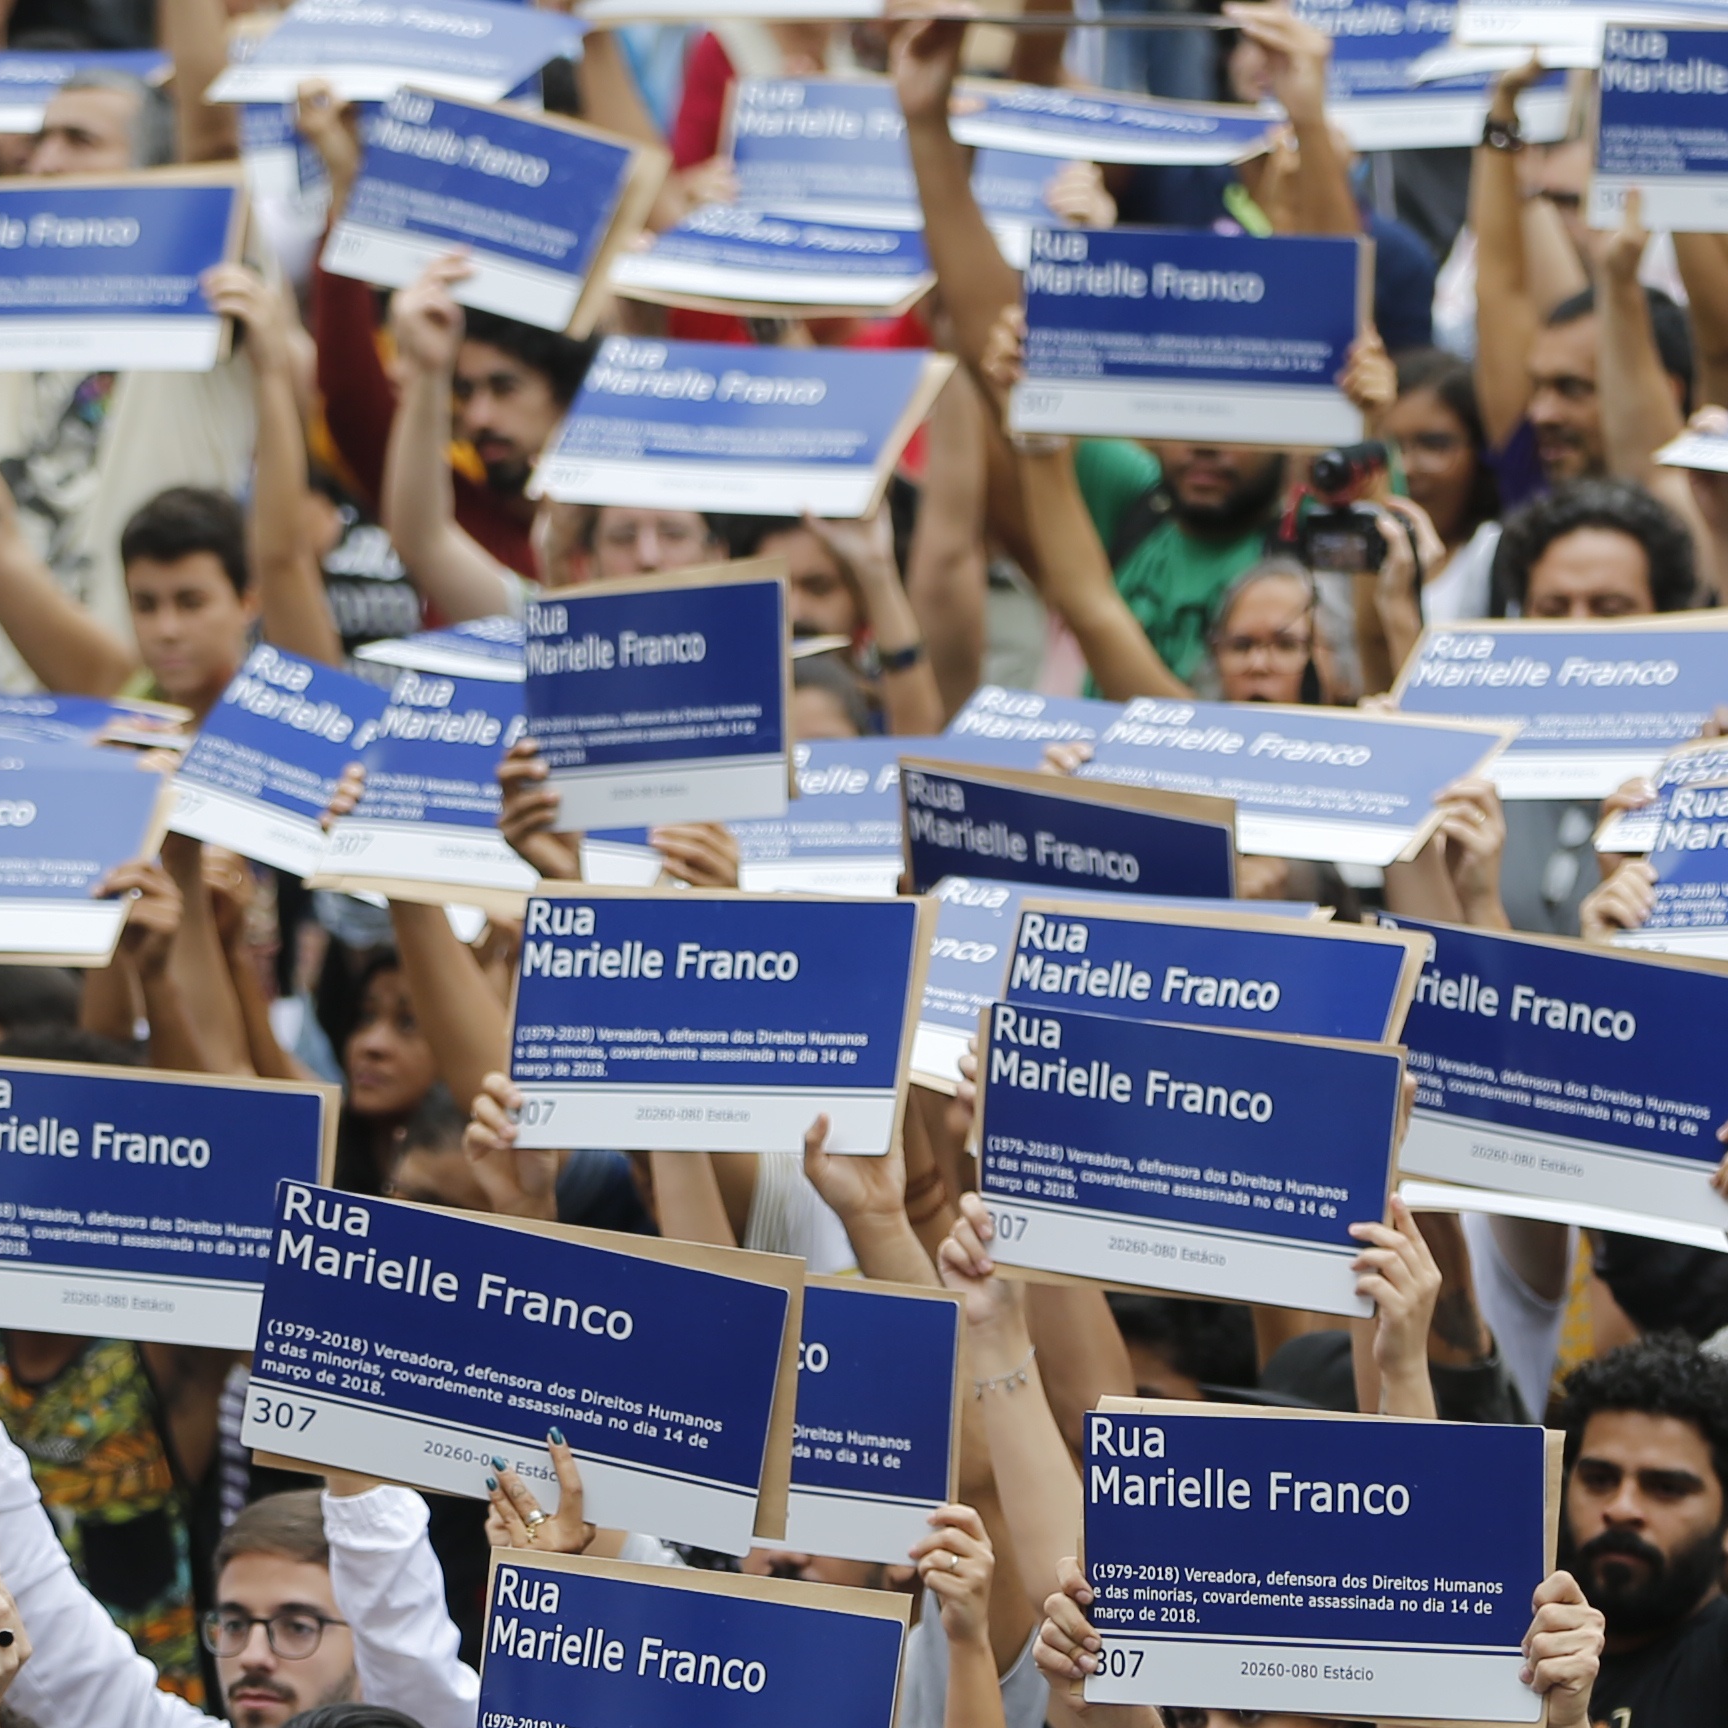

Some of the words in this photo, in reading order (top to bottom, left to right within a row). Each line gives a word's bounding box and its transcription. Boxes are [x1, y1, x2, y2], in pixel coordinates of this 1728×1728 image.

[908, 773, 965, 813] Rua
[909, 808, 1028, 863] Marielle
[1034, 830, 1140, 884] Franco
[526, 897, 595, 935] Rua
[1019, 914, 1089, 953] Rua
[523, 941, 663, 978] Marielle
[676, 943, 798, 980] Franco
[1011, 954, 1152, 1001] Marielle
[1161, 967, 1281, 1012] Franco
[992, 1001, 1061, 1049] Rua
[991, 1048, 1131, 1102] Marielle
[1146, 1071, 1272, 1122] Franco
[282, 1179, 369, 1237] Rua
[277, 1229, 458, 1302] Marielle
[478, 1273, 632, 1340] Franco
[253, 1398, 316, 1431] 307
[1092, 1417, 1164, 1458] Rua
[1092, 1466, 1250, 1509] Marielle
[1270, 1472, 1409, 1515] Franco
[498, 1568, 559, 1613] Rua
[1093, 1563, 1179, 1584] (1979-2018)
[1185, 1568, 1261, 1587] Vereadora,
[1267, 1571, 1336, 1587] defensora
[1342, 1574, 1367, 1588] dos
[1373, 1575, 1428, 1591] Direitos
[1434, 1578, 1502, 1594] Humanos
[1091, 1587, 1101, 1600] e
[1106, 1585, 1128, 1599] das
[1134, 1587, 1197, 1605] minorias,
[1203, 1590, 1303, 1607] covardemente
[1309, 1595, 1394, 1610] assassinada
[1400, 1600, 1417, 1611] no
[1423, 1598, 1444, 1612] dia
[1452, 1599, 1468, 1613] 14
[1474, 1600, 1492, 1614] de
[1094, 1607, 1134, 1623] março
[1139, 1607, 1155, 1621] de
[1161, 1608, 1200, 1623] 2018.
[491, 1616, 623, 1671] Marielle
[638, 1637, 765, 1692] Franco
[1094, 1648, 1145, 1678] 307
[1241, 1662, 1317, 1678] 20260-080
[1324, 1665, 1373, 1681] Estácio
